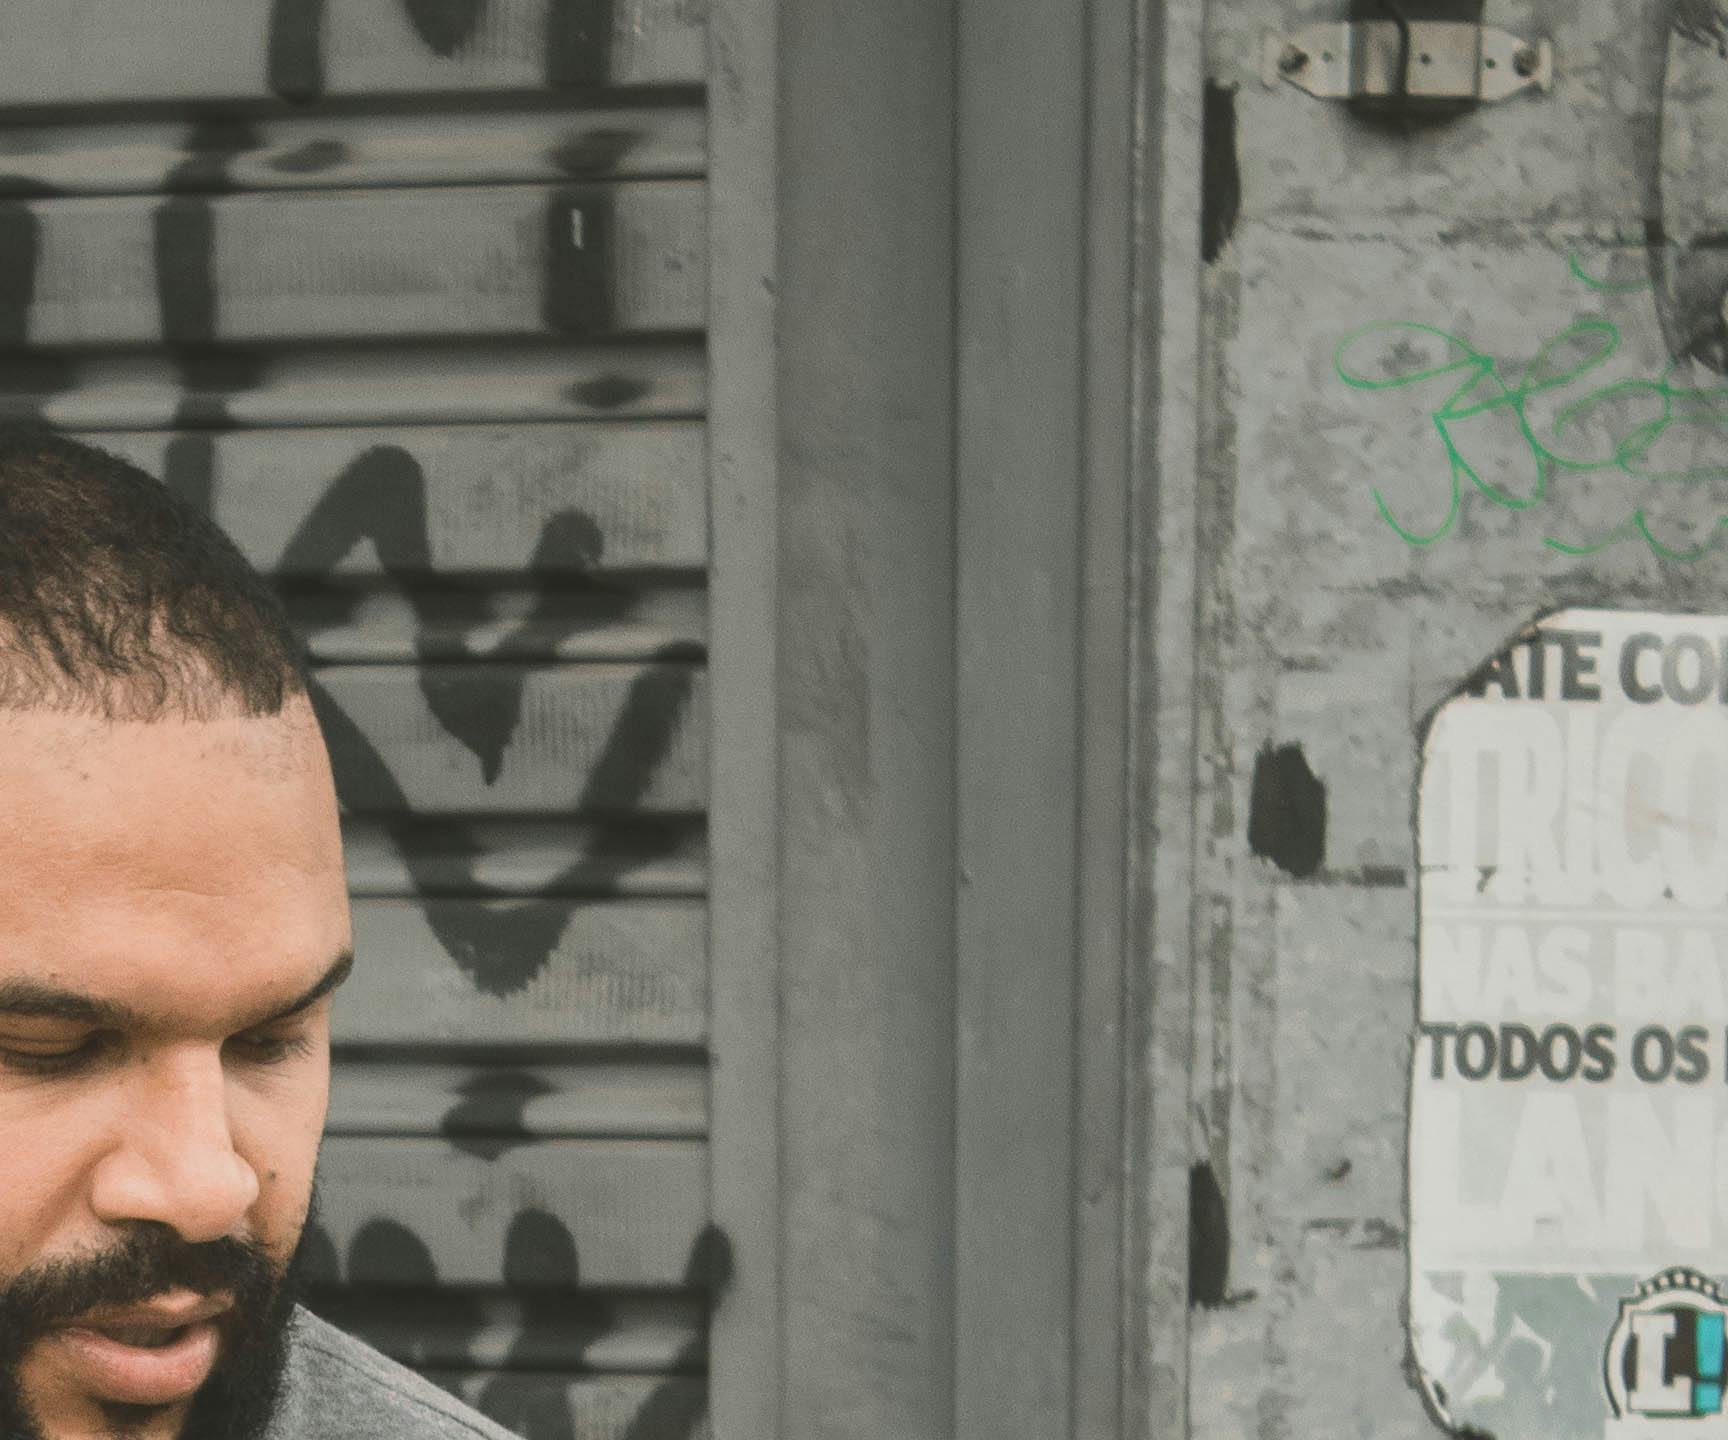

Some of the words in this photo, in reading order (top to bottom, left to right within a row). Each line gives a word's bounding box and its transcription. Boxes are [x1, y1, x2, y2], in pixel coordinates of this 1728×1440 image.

[1618, 632, 1728, 706] CO
[1420, 1022, 1617, 1083] TODOS
[1630, 1024, 1712, 1084] OS
[1419, 1088, 1728, 1250] LAN
